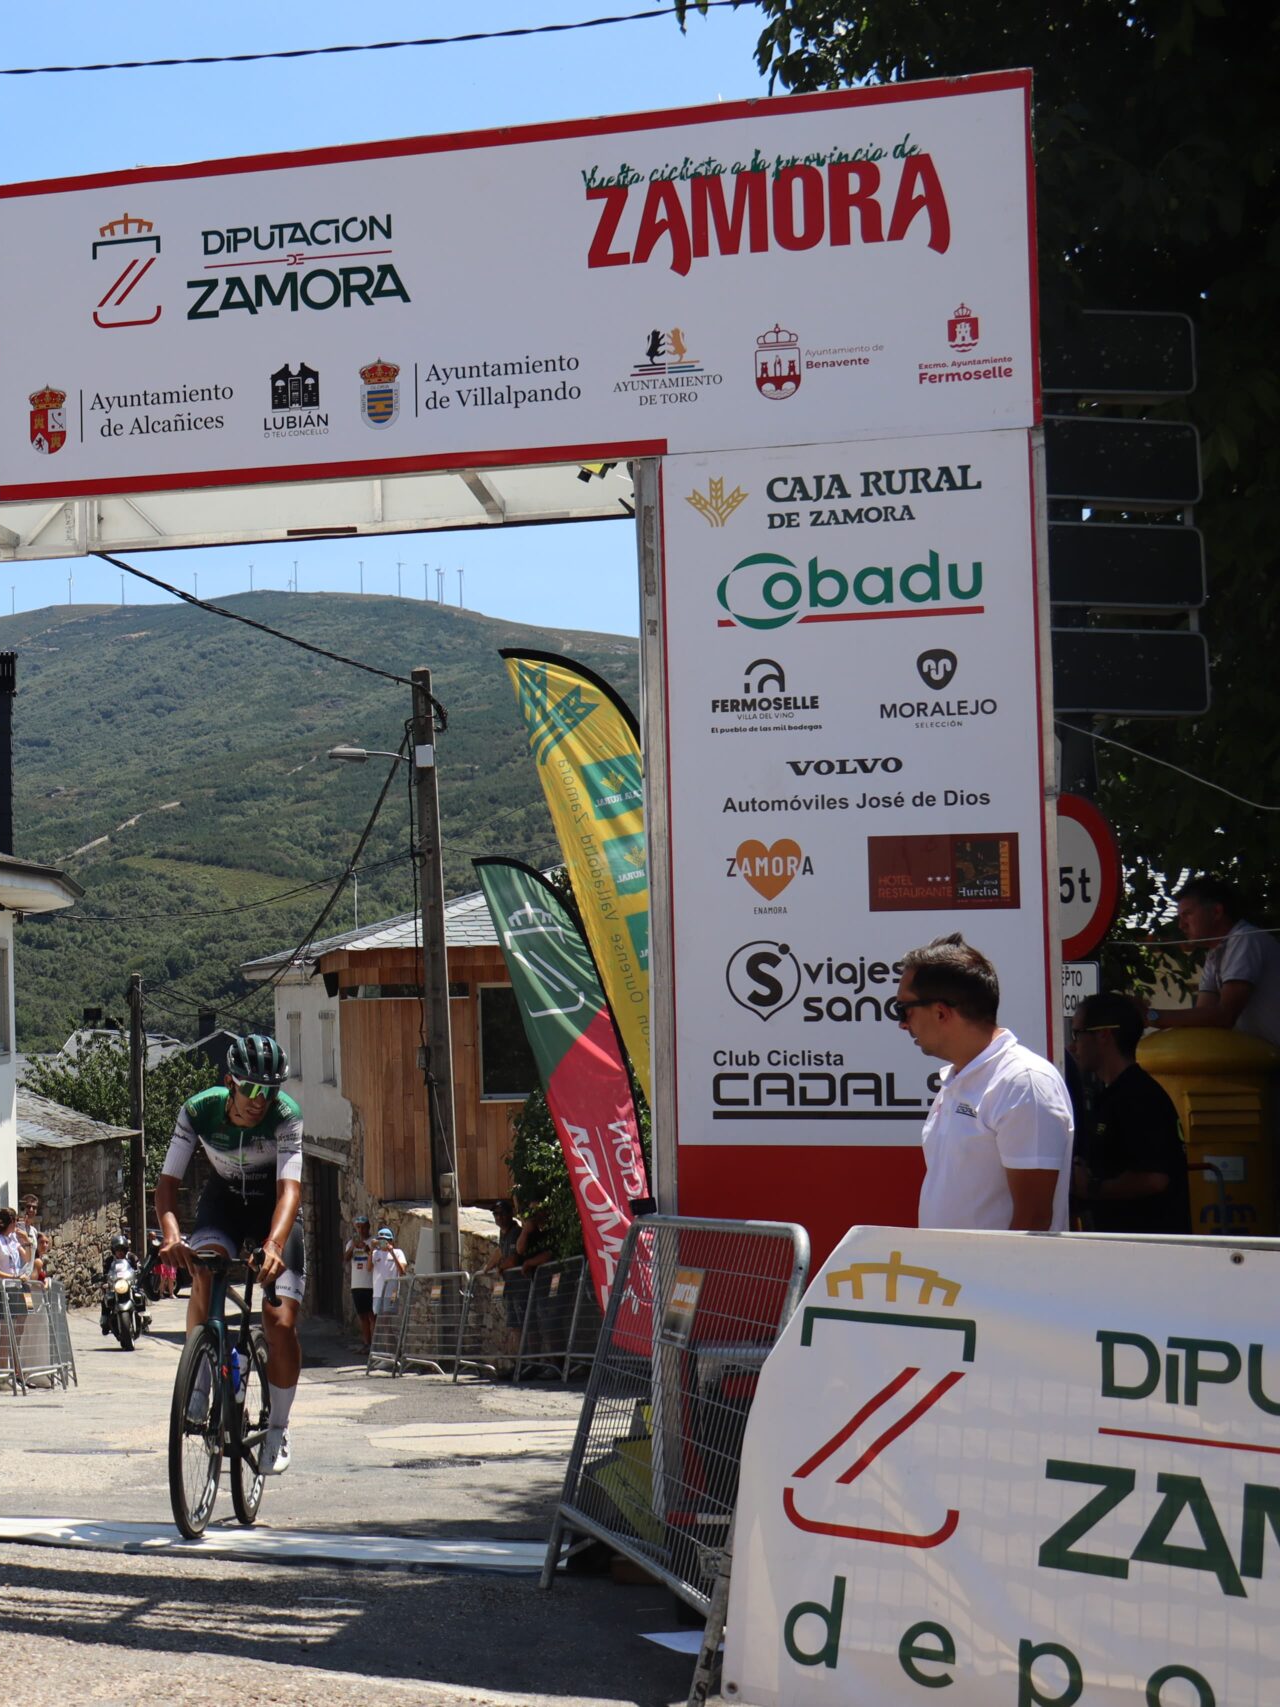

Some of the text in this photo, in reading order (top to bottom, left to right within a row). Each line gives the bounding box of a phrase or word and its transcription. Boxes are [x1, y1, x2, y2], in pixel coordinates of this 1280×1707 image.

[649, 156, 727, 182] ciclista
[730, 161, 747, 175] a
[892, 132, 922, 160] de
[585, 152, 951, 278] ZAMORA
[186, 263, 412, 321] ZAMORA
[805, 343, 885, 357] Ayuntamiento de
[425, 354, 580, 387] Ayuntamiento
[805, 356, 870, 370] Benavente
[918, 355, 1013, 371] Excmo. Ayuntamiento
[613, 374, 723, 394] AYUNTAMIENTO
[919, 365, 1013, 385] Fermoselle
[89, 384, 234, 416] Ayuntamiento
[425, 391, 451, 411] de
[456, 381, 582, 409] Villalpando
[639, 391, 698, 407] DE TORO
[100, 413, 225, 438] de Alcañices
[263, 411, 329, 431] LUBIÁN
[766, 464, 982, 503] CAJA RURAL
[767, 504, 916, 530] DE ZAMORA
[717, 548, 983, 631] Cobadu
[711, 695, 820, 714] FERMOSELLE
[880, 698, 998, 719] MORALEJO
[737, 711, 795, 721] VILLA DEL VINO
[720, 725, 747, 735] pueblo
[759, 724, 772, 732] las
[773, 723, 787, 732] mil
[788, 722, 823, 734] bodegas
[786, 757, 903, 776] VOLVO
[722, 789, 991, 813] Automóviles José de Dios
[726, 855, 815, 879] ZAMORA
[753, 905, 788, 916] ENAMORA
[713, 1050, 845, 1067] Club Ciclista
